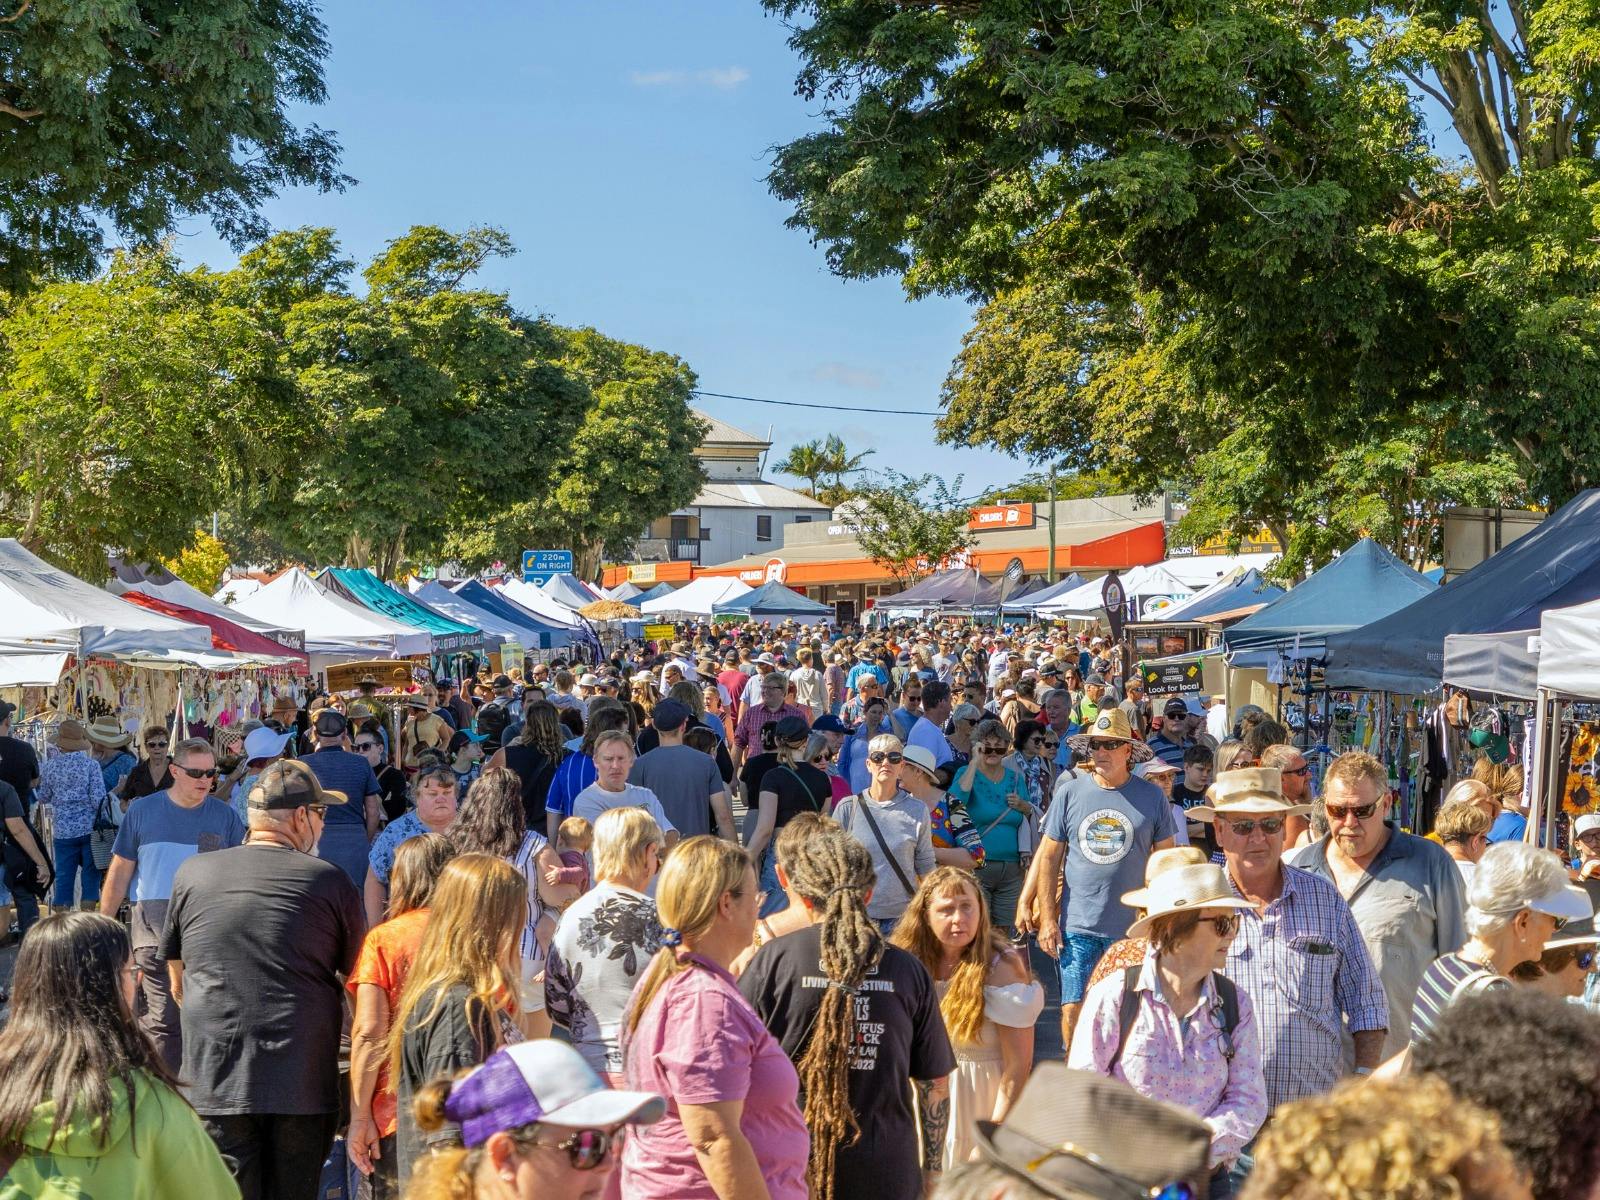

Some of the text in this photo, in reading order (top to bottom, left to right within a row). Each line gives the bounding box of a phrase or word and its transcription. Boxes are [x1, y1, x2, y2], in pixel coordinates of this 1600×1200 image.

[542, 553, 565, 561] 220m
[1148, 685, 1166, 694] Look
[1179, 682, 1200, 691] local
[857, 980, 895, 993] ESTIVAL
